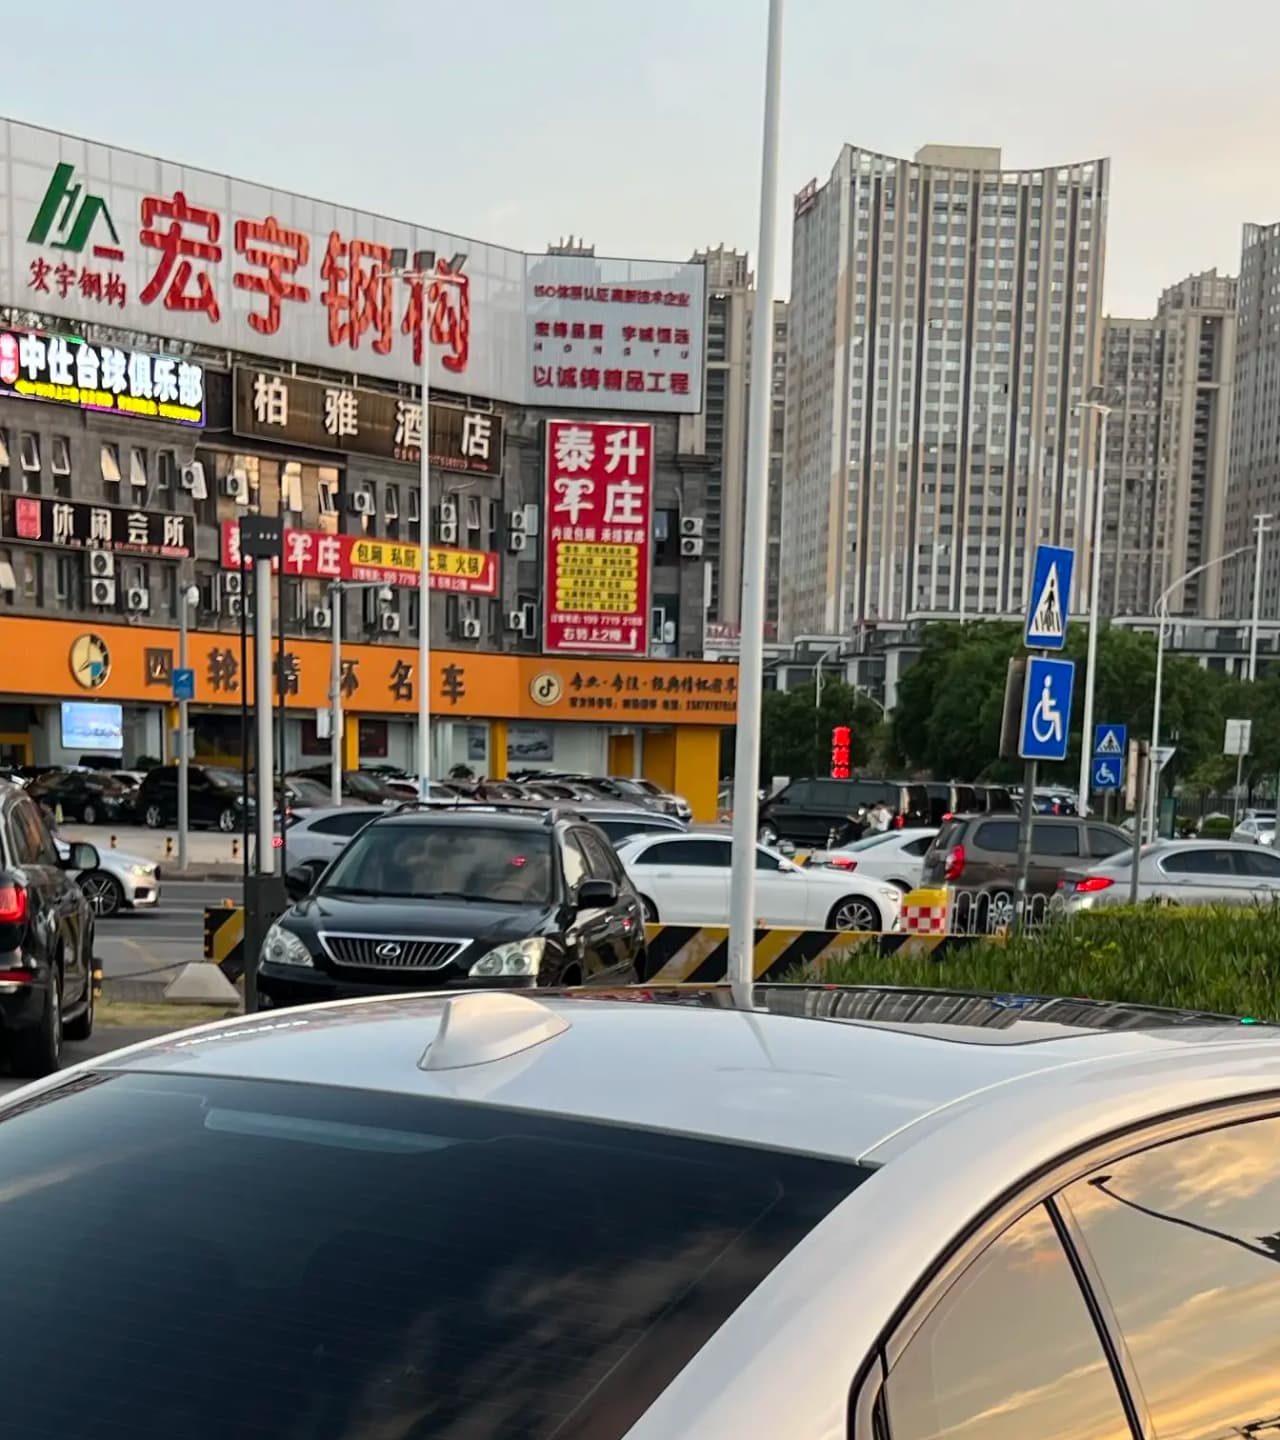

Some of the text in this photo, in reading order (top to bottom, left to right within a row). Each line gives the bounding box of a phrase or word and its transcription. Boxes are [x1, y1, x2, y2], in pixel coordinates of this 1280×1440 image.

[139, 191, 471, 373] 宏宇钢构
[253, 373, 492, 460] 柏雅酒店
[554, 427, 645, 476] 泰升
[52, 502, 185, 547] 休闲会所
[553, 478, 645, 526] 羊庄
